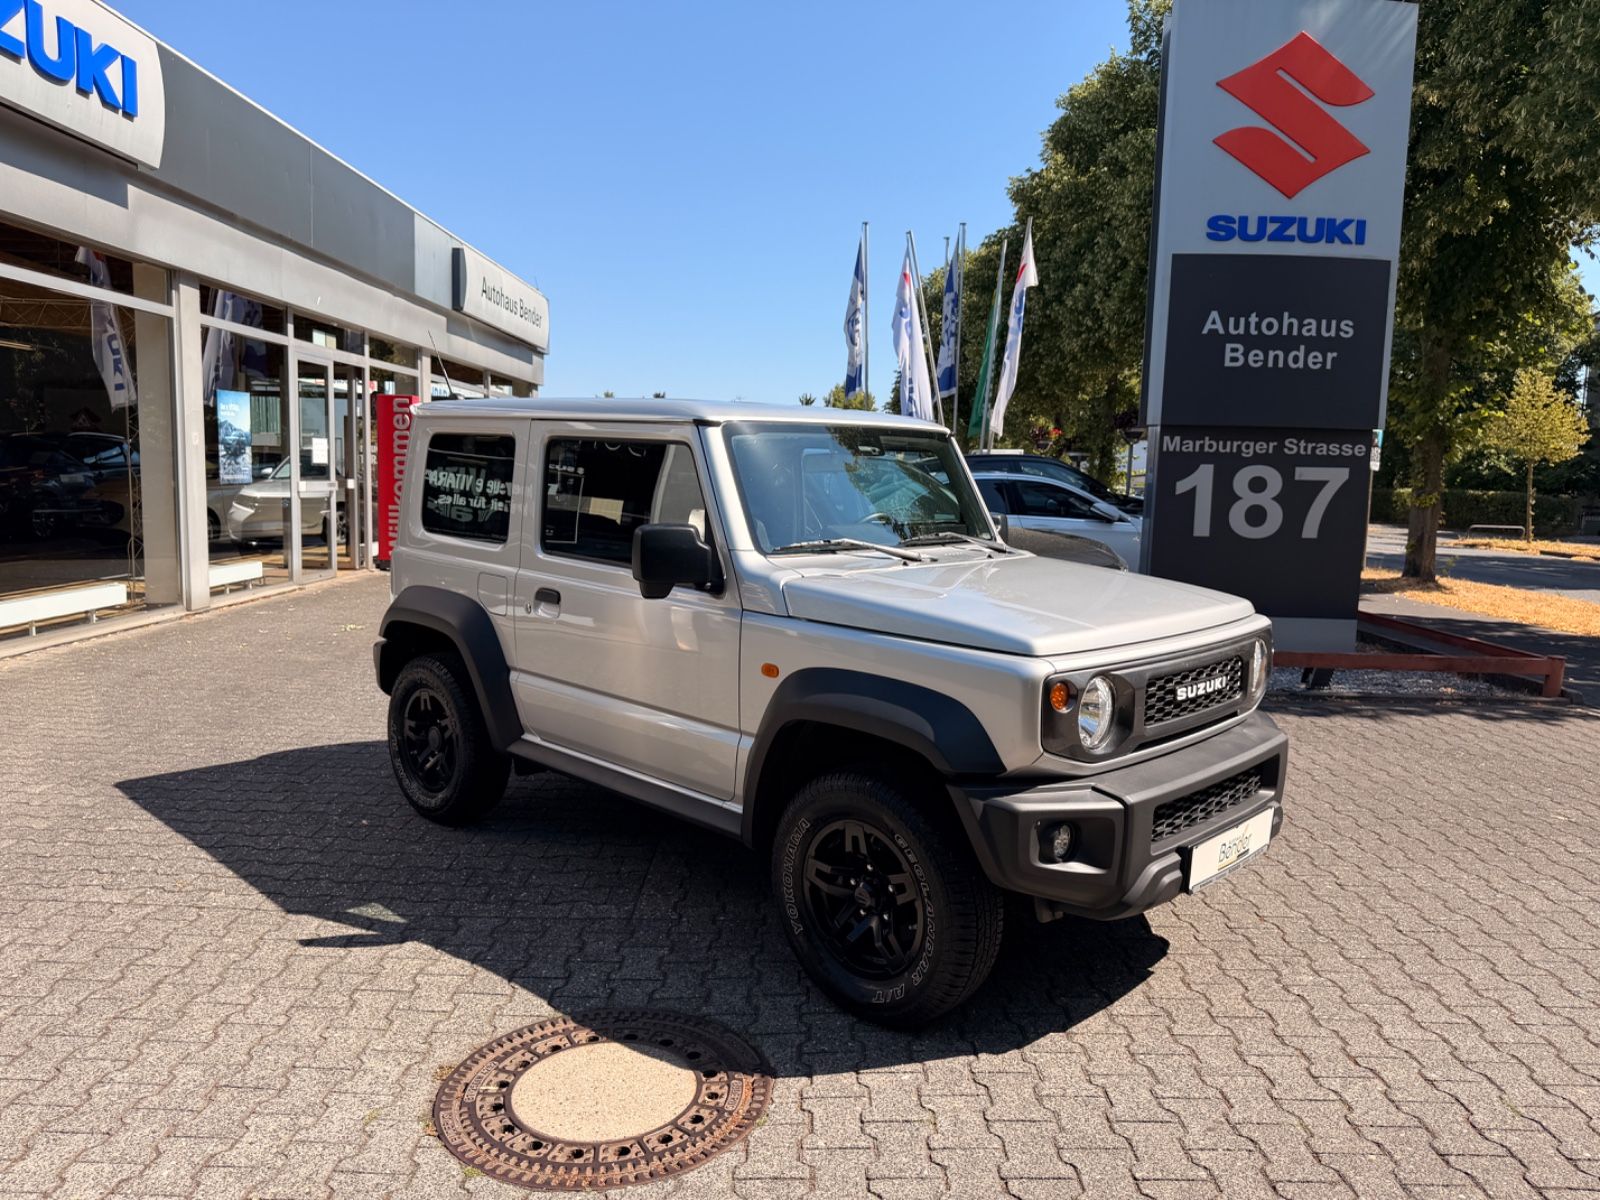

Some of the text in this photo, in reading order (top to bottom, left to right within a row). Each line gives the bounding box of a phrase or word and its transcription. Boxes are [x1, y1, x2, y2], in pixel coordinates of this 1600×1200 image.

[1206, 214, 1367, 245] SUZUKI
[481, 276, 542, 328] Autohaus Bender
[1201, 310, 1354, 338] Autohaus
[1224, 343, 1337, 370] Bender
[1162, 435, 1367, 457] Marburger Strasse
[1174, 463, 1350, 539] 187
[1176, 675, 1229, 701] SUZUKI
[783, 818, 811, 935] YOKOHAMA
[894, 833, 936, 985] GEOLANDAR
